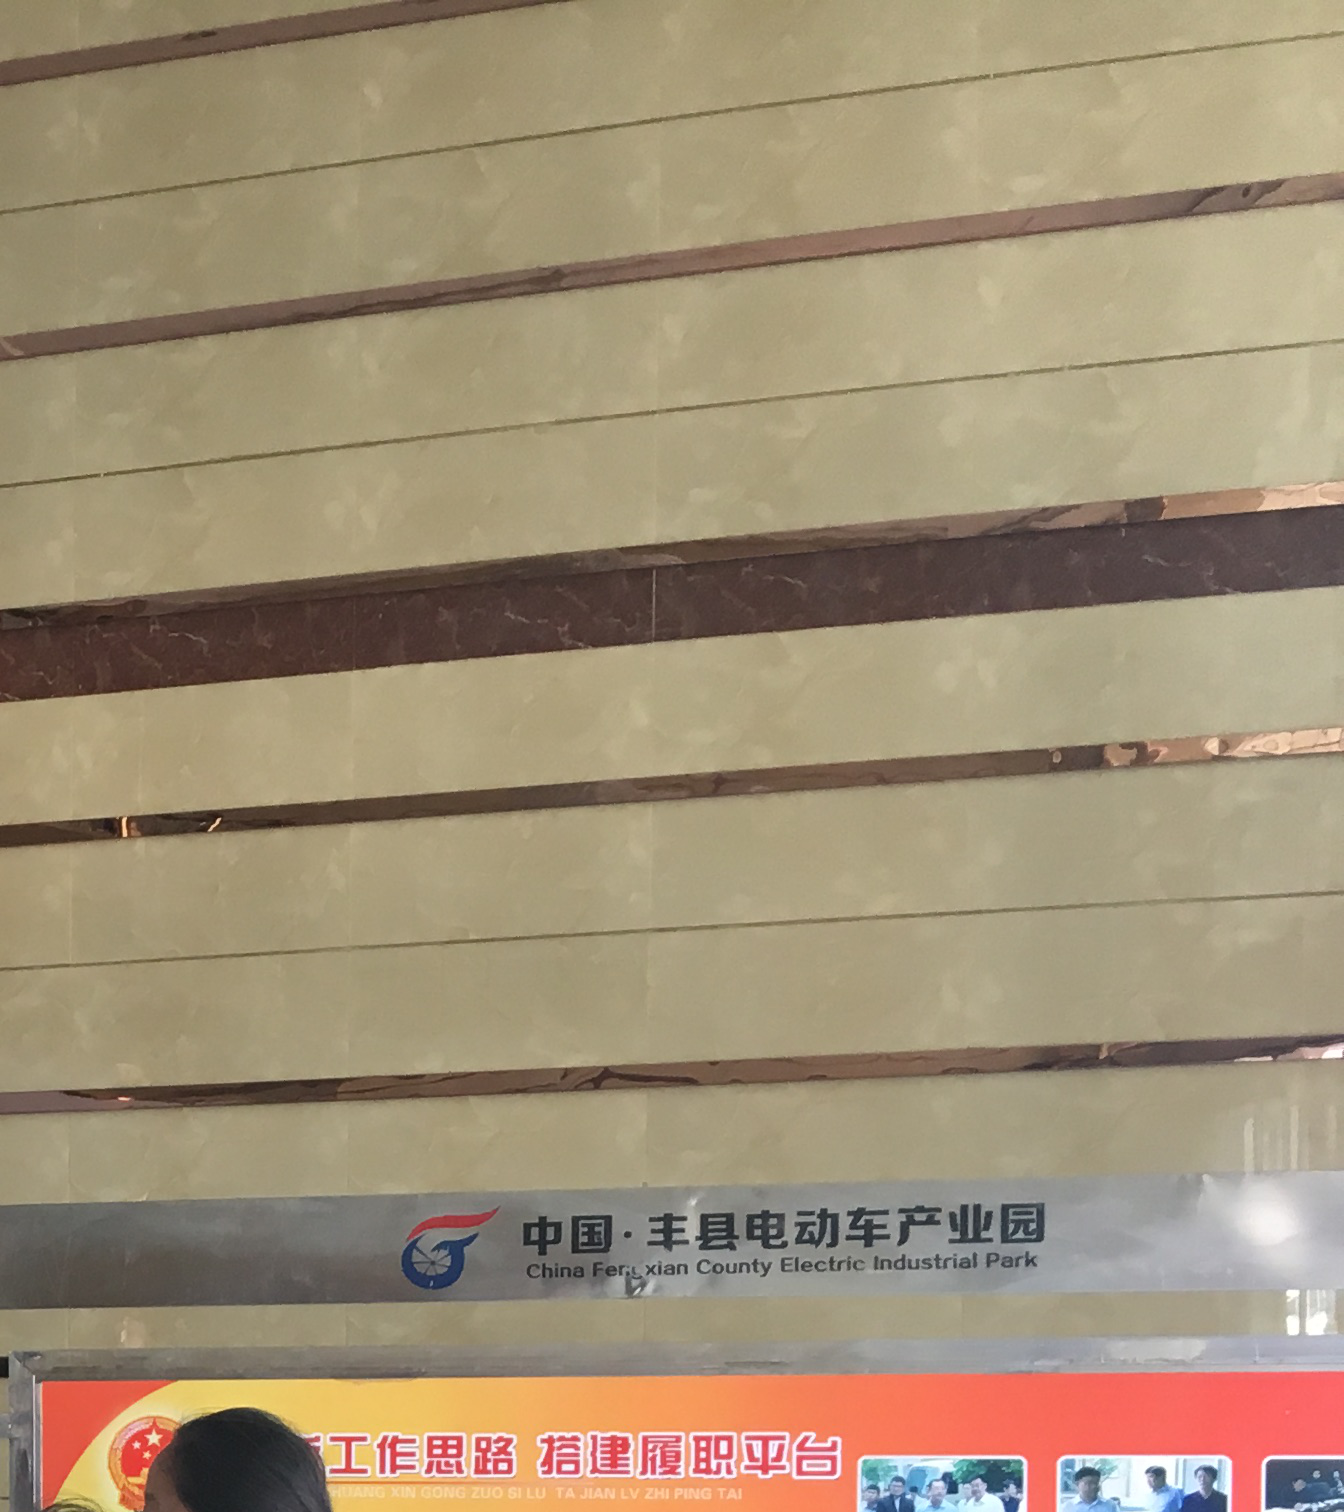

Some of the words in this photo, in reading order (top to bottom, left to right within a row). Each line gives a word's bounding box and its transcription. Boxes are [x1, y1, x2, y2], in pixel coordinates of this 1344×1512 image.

[521, 1202, 1045, 1256] 中国·丰县电动车产业园
[525, 1261, 587, 1279] China
[696, 1258, 773, 1278] County
[780, 1254, 866, 1274] Electric
[873, 1251, 979, 1271] Industrial
[985, 1251, 1038, 1270] Park
[537, 1432, 843, 1480] 搭建履职平台
[390, 1485, 416, 1499] XIN
[420, 1485, 467, 1500] GONG
[471, 1486, 504, 1500] ZUO
[507, 1486, 523, 1500] SI
[526, 1486, 546, 1500] LU
[556, 1486, 576, 1500] TA
[580, 1486, 616, 1501] JIAN
[619, 1486, 640, 1501] LV
[644, 1487, 670, 1501] ZHI
[674, 1487, 713, 1501] PING
[717, 1487, 743, 1501] TAI
